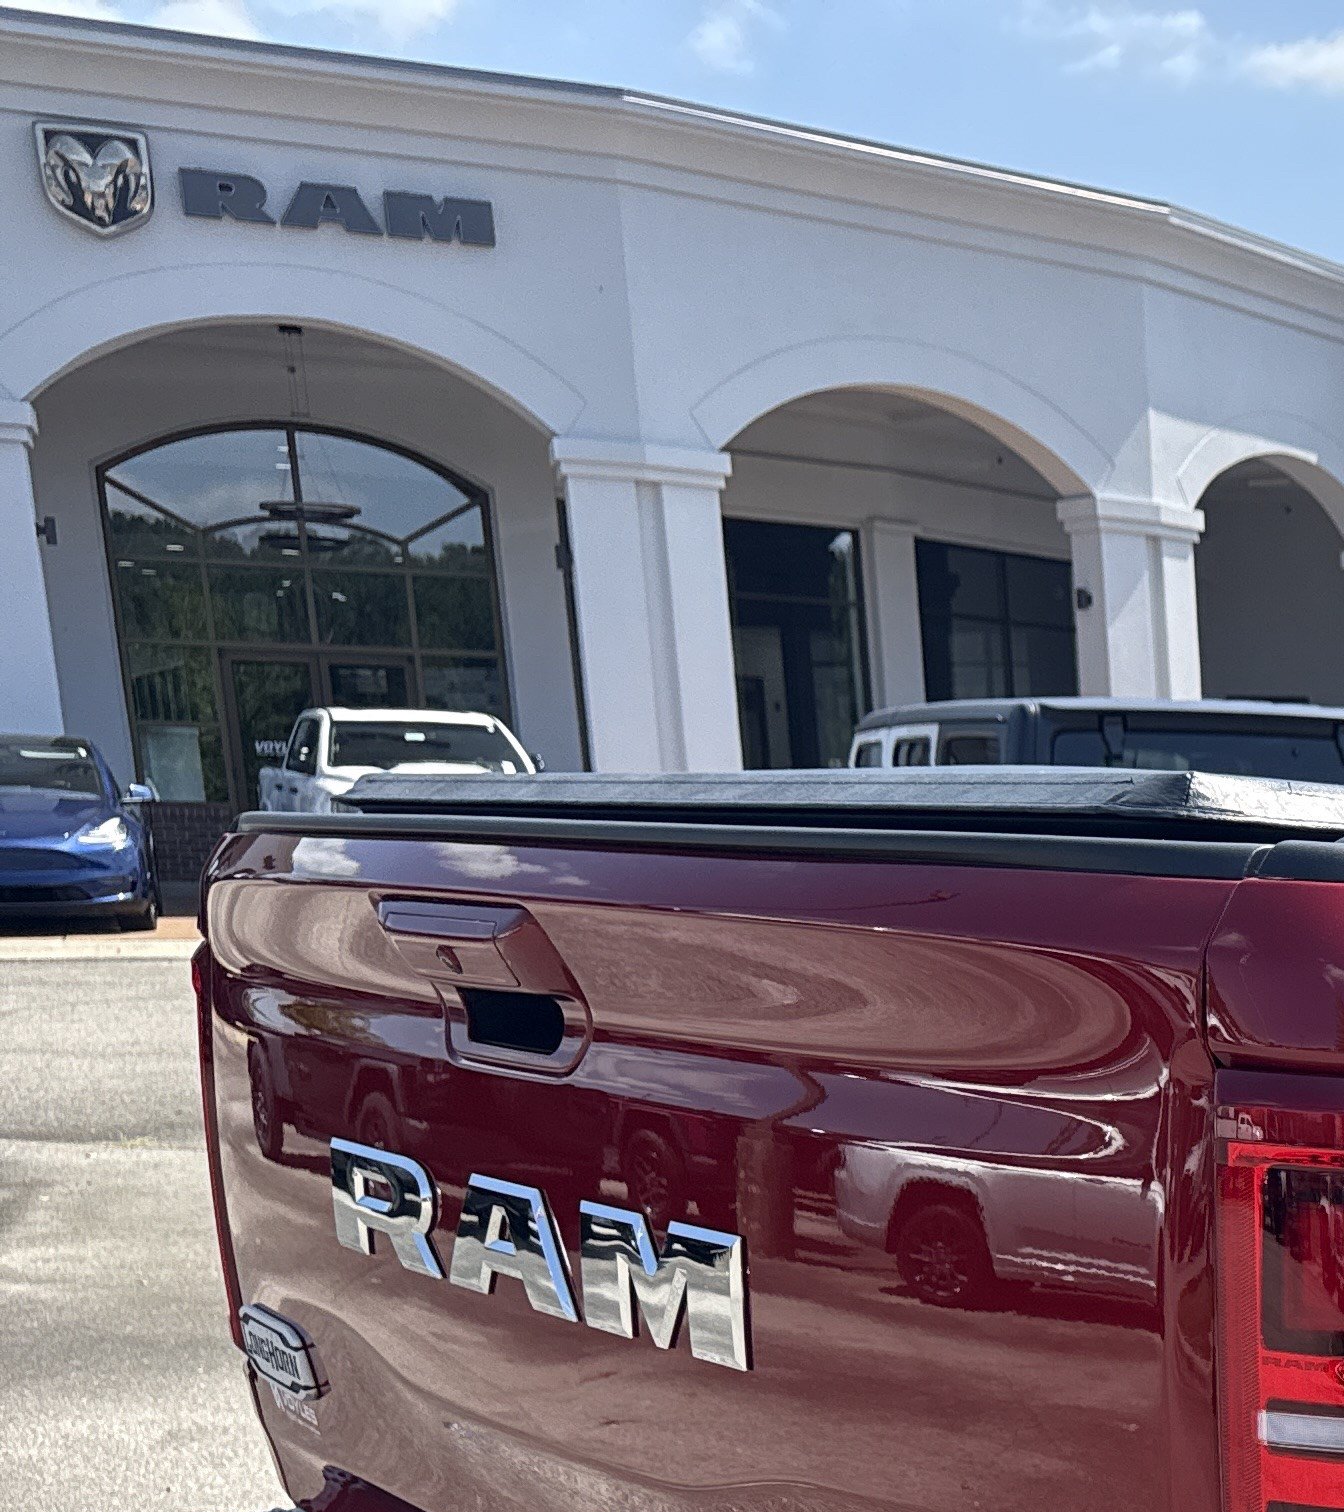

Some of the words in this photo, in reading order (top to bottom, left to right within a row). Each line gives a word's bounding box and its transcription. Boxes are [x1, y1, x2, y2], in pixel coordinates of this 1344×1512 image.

[178, 166, 496, 248] RAM
[330, 1137, 753, 1372] RAM
[1262, 1355, 1330, 1373] RAM
